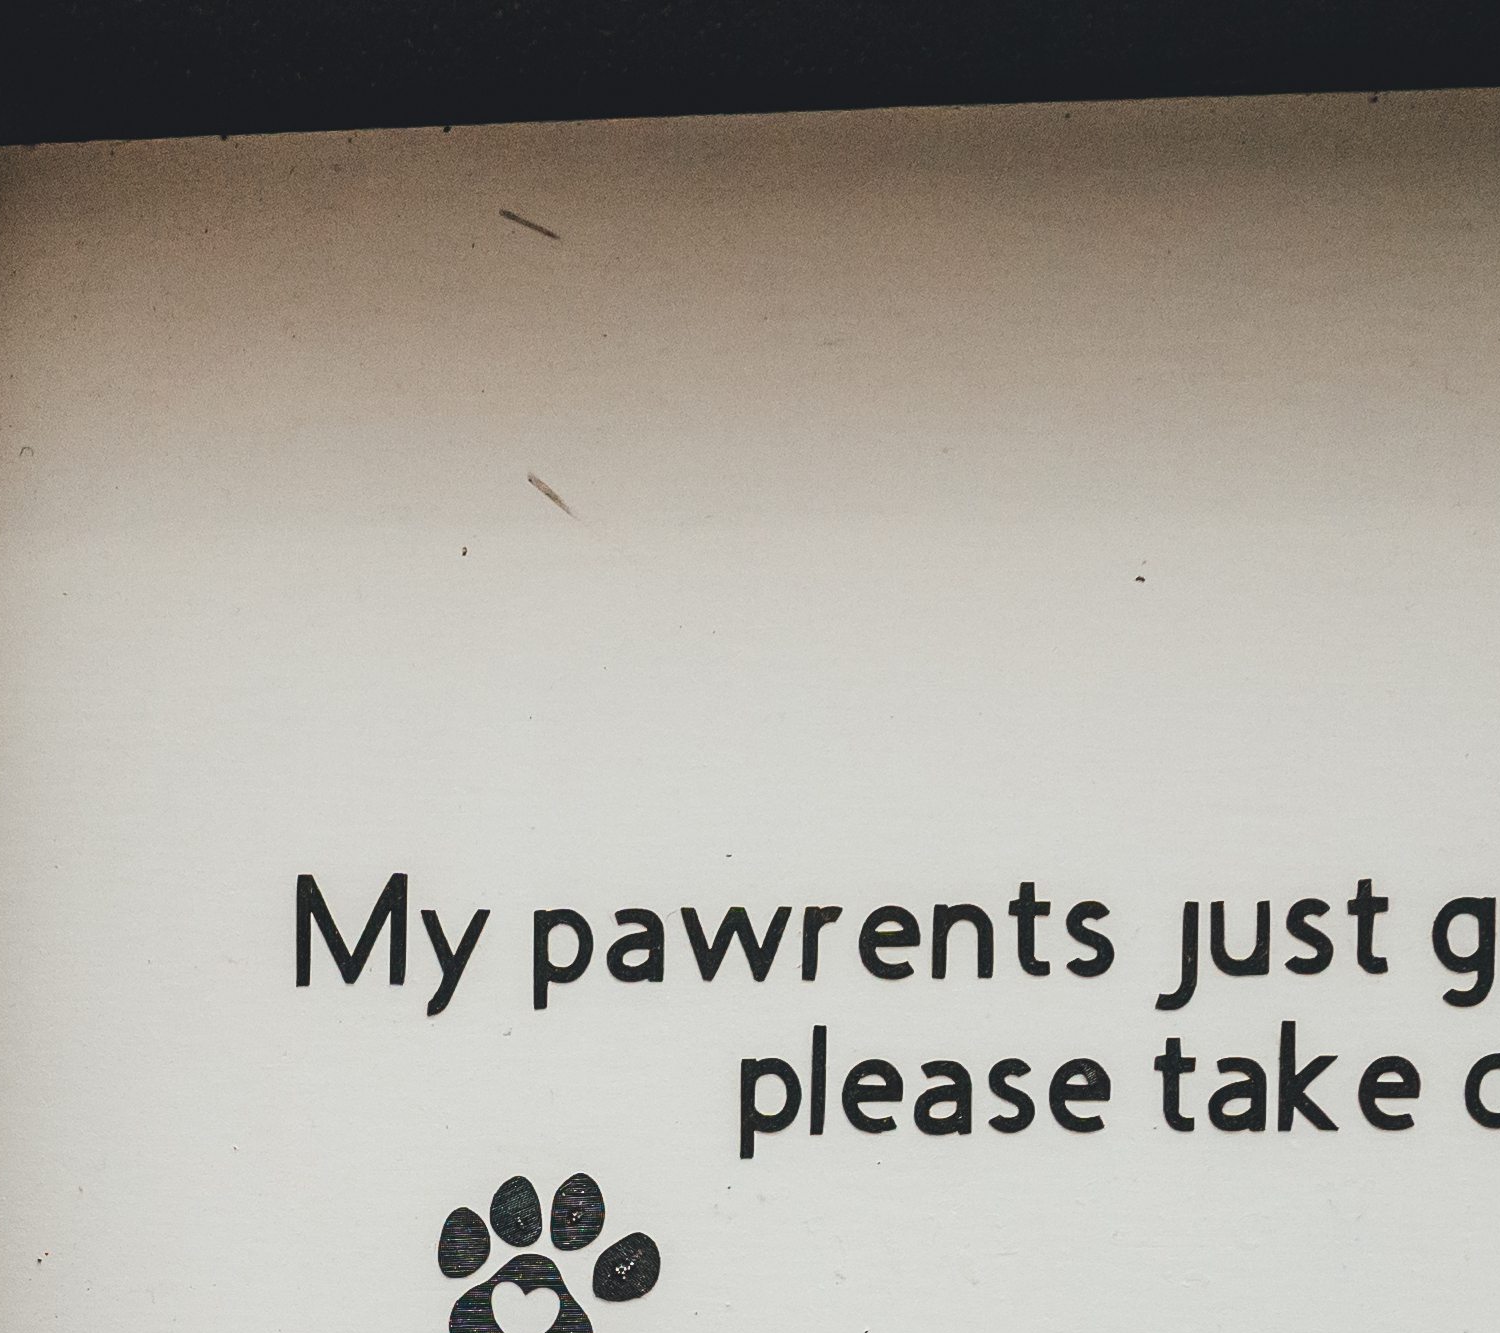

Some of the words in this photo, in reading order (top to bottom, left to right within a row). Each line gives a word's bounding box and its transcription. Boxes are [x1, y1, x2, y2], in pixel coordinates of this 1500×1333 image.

[296, 873, 490, 1017] My
[533, 882, 1115, 1008] pawrents
[1155, 879, 1389, 1011] just
[740, 1025, 1111, 1158] please
[1154, 1021, 1421, 1132] take
